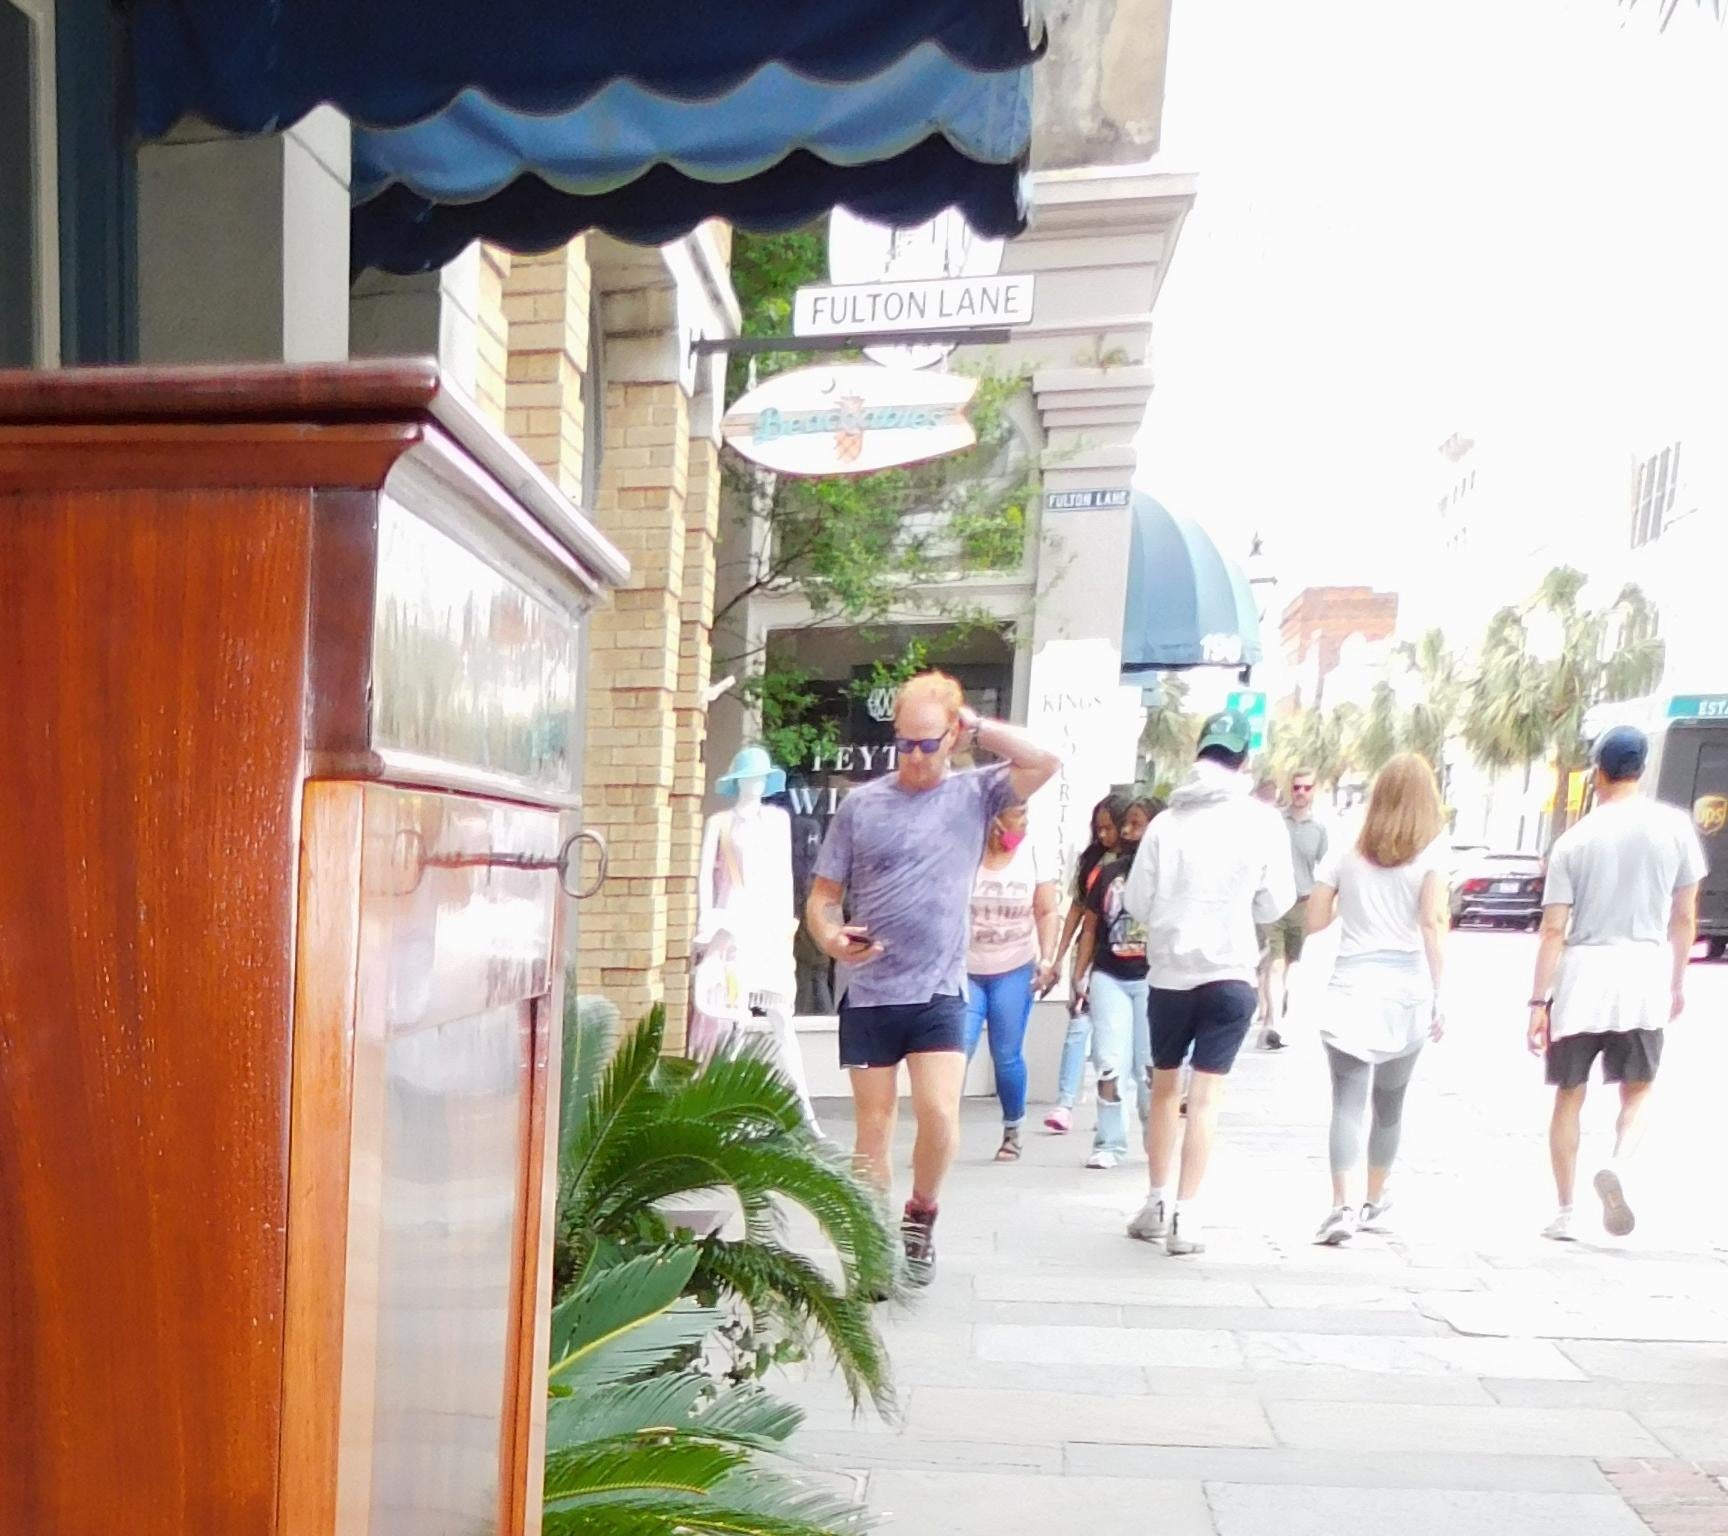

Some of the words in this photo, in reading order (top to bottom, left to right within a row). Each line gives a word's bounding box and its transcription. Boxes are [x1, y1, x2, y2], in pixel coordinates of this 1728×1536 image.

[811, 291, 927, 325] FULTON
[938, 285, 1020, 318] LANE
[1048, 491, 1092, 508] FULTON
[1095, 489, 1127, 506] LANE
